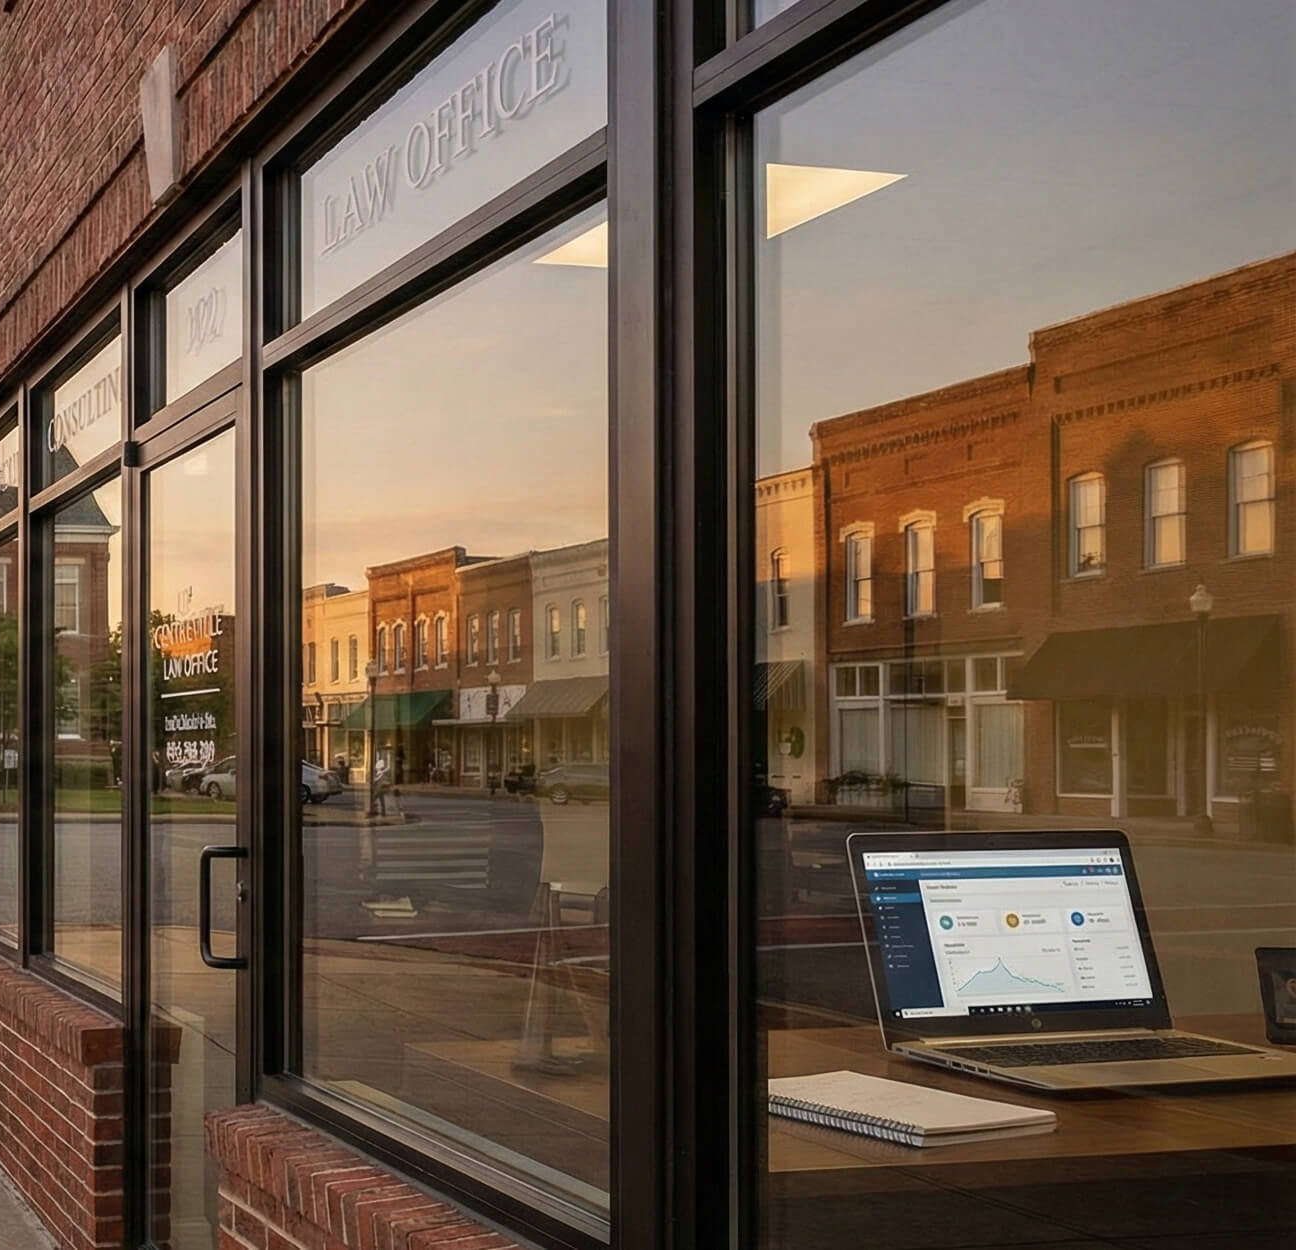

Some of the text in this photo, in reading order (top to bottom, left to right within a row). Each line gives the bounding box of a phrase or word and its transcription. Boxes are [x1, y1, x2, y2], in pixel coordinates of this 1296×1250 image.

[321, 13, 566, 256] LAW OFFICE
[164, 649, 219, 680] LAW OFFICE
